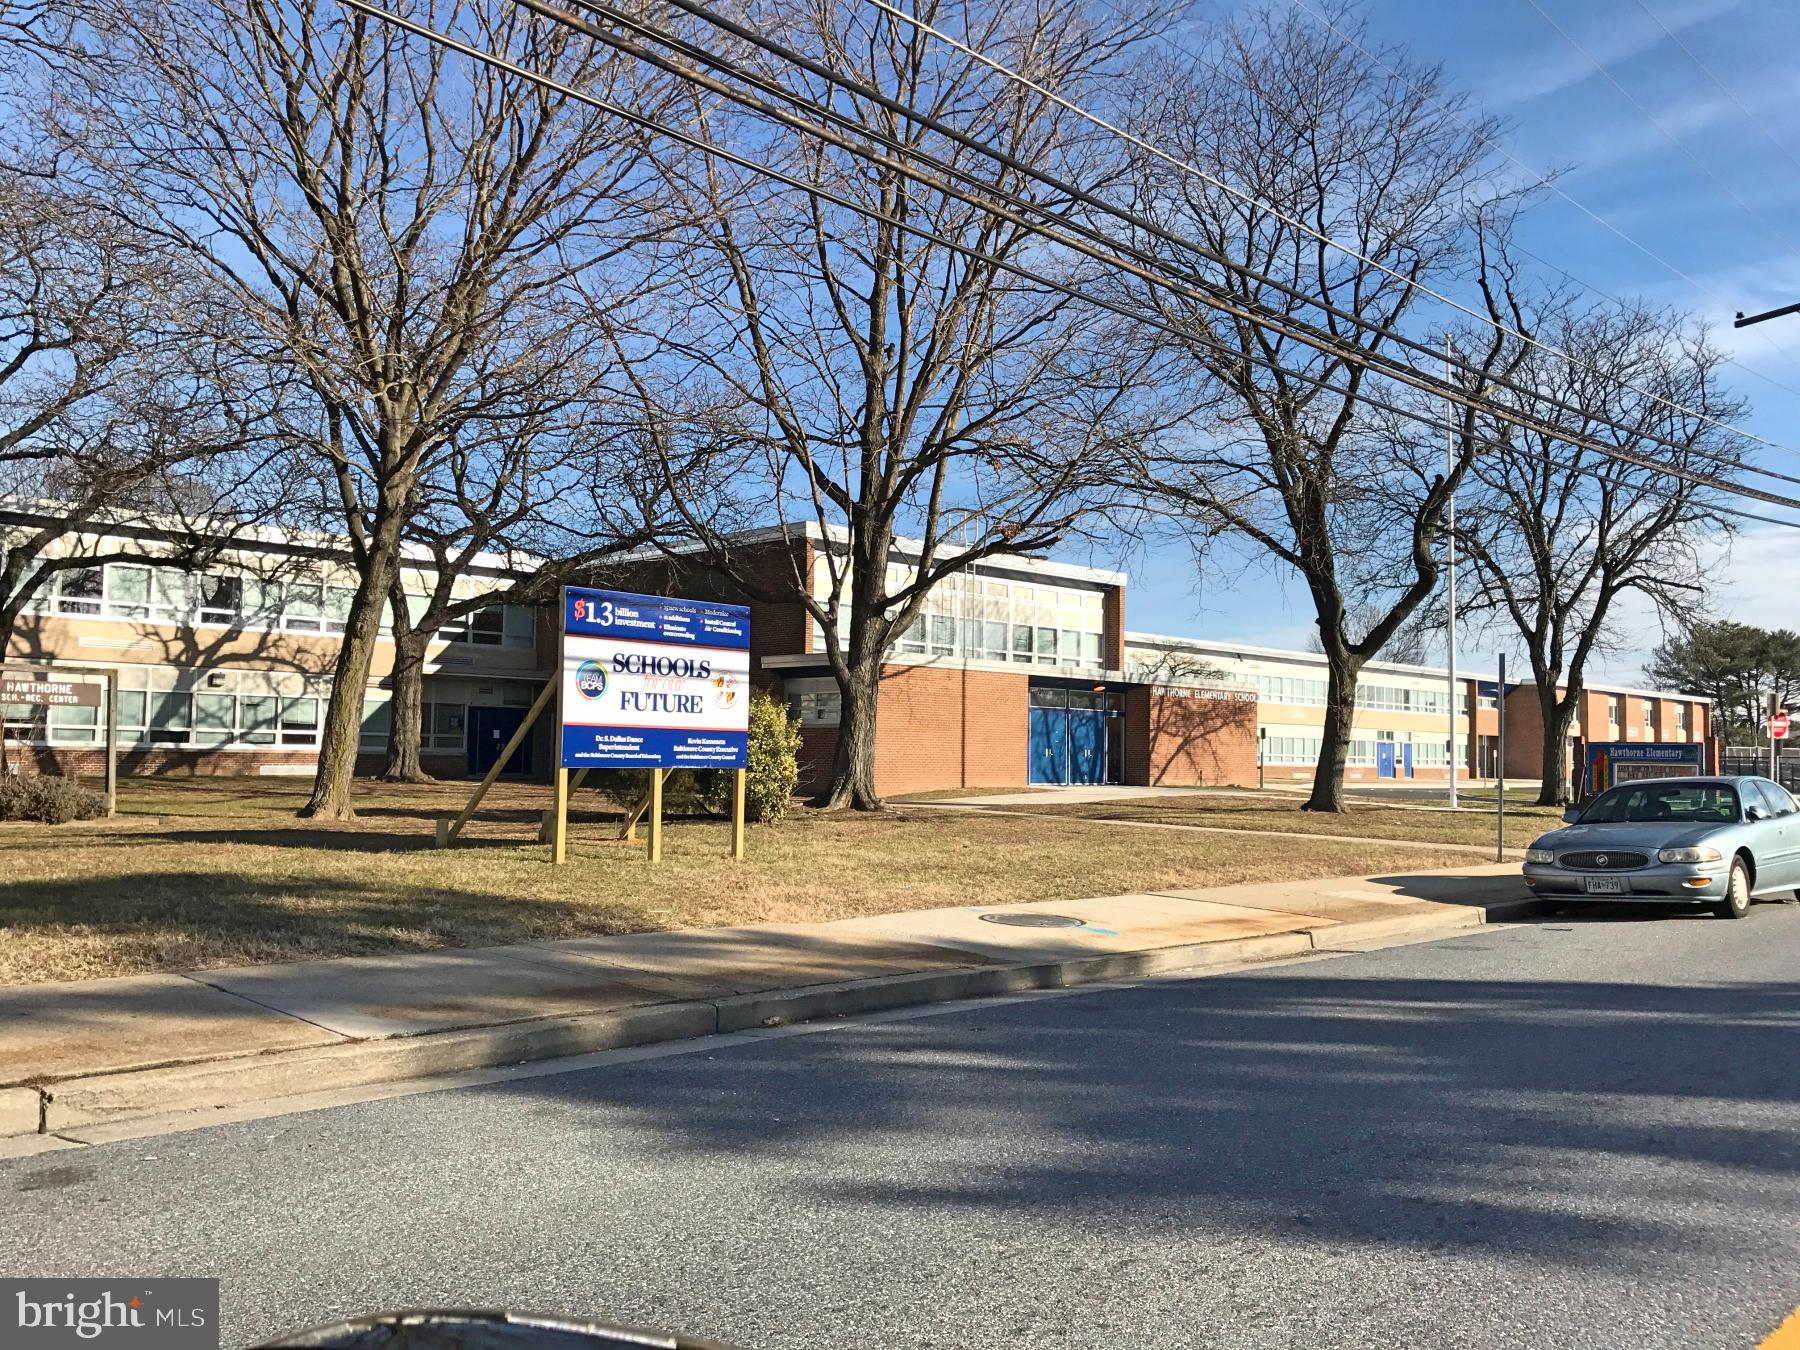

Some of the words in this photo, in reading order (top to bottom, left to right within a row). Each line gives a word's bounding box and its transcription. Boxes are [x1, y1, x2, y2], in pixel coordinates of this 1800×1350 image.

[574, 598, 613, 627] $1.3
[614, 607, 639, 618] billion
[614, 616, 656, 629] investment
[612, 653, 711, 679] SCHOOLS
[582, 673, 603, 684] TEAM
[6, 682, 73, 695] HAWTHORNE
[581, 681, 604, 692] BCPS
[49, 695, 78, 704] CENTER
[1152, 685, 1192, 699] HAWTHORNE
[1194, 690, 1231, 701] ELEMENTARY
[1234, 692, 1257, 703] SCHOOL
[620, 691, 704, 714] FUTURE
[1609, 747, 1644, 758] Hawthorne
[1646, 748, 1682, 760] Elementary
